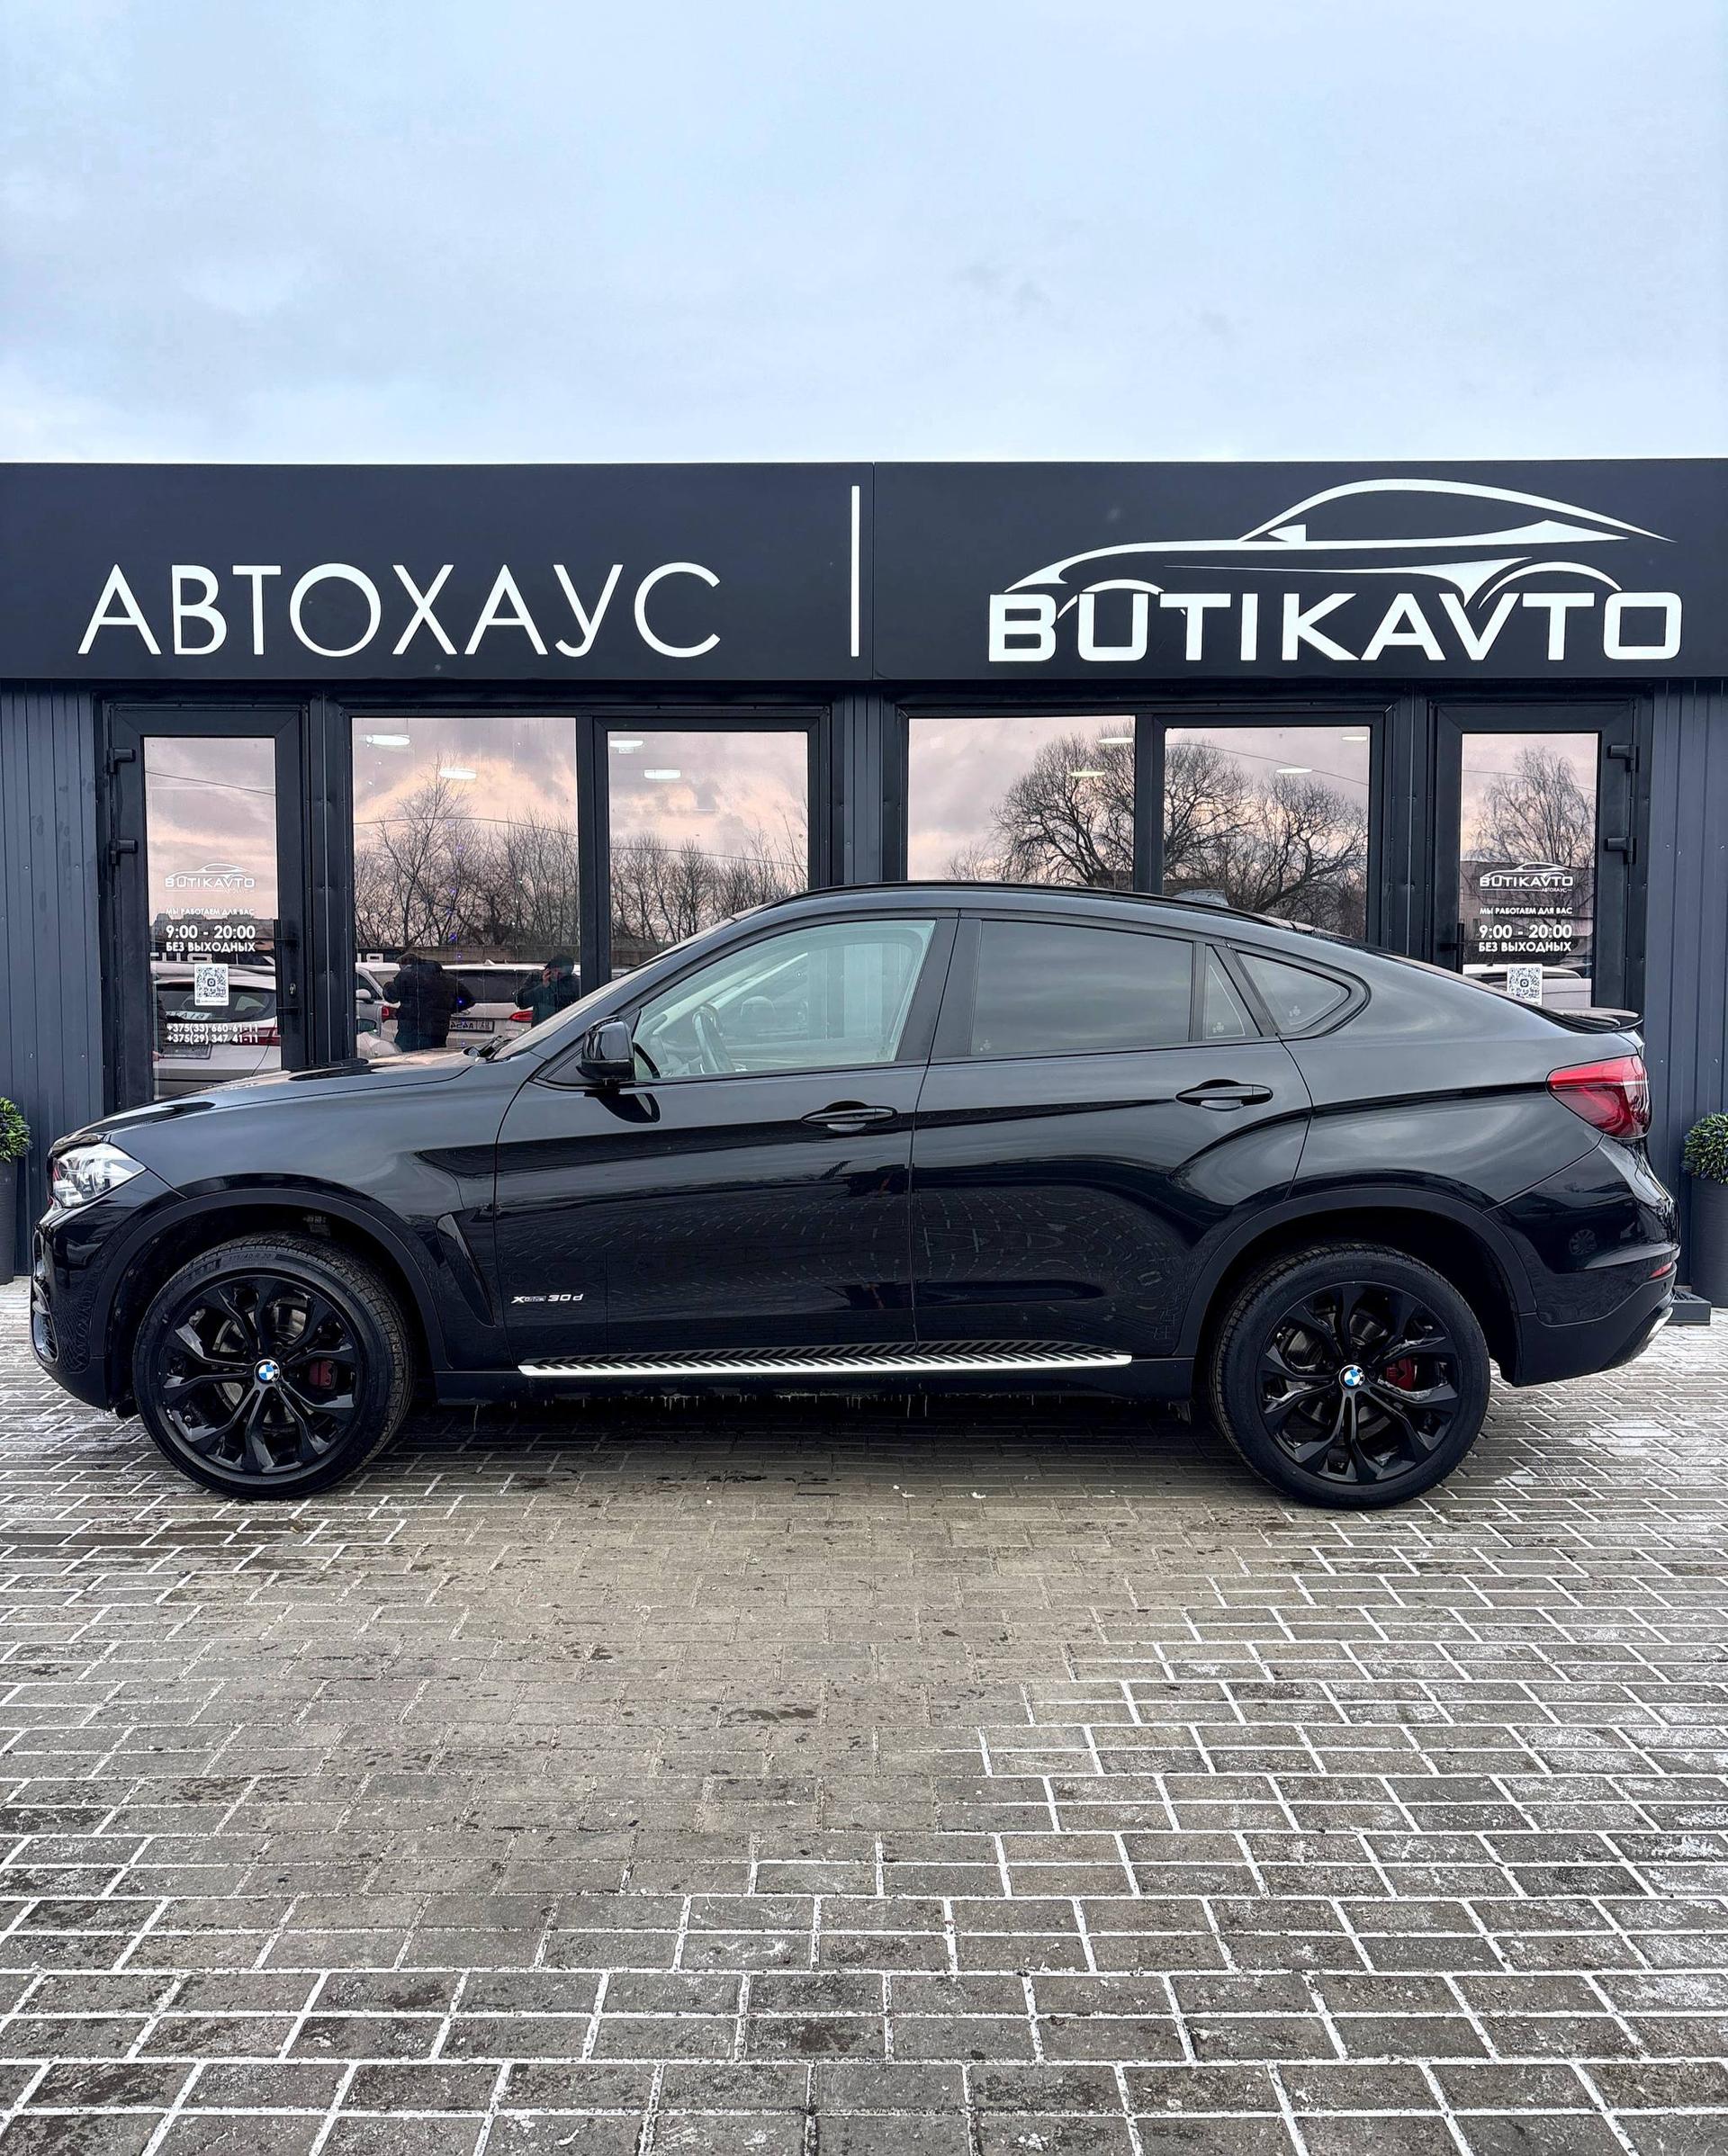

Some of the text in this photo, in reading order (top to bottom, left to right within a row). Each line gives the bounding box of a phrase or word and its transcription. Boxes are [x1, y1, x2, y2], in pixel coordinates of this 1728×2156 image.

[77, 561, 721, 659] АВТОХАУС
[988, 592, 1681, 662] BUTIKAVTO
[165, 877, 255, 887] BUTIKAVTO
[1480, 876, 1573, 886] BUTIKAVTO
[166, 925, 198, 939] 9:00
[213, 925, 256, 939] 20:00
[1479, 924, 1512, 939] 9:00
[1528, 924, 1572, 939] 20:00
[166, 941, 256, 953] БЕЗ ВЫХОДНЫХ
[1479, 941, 1571, 953] БЕЗ ВЫХОДНЫХ
[166, 1023, 209, 1034] +375(33)
[166, 1033, 209, 1045] +375(29)
